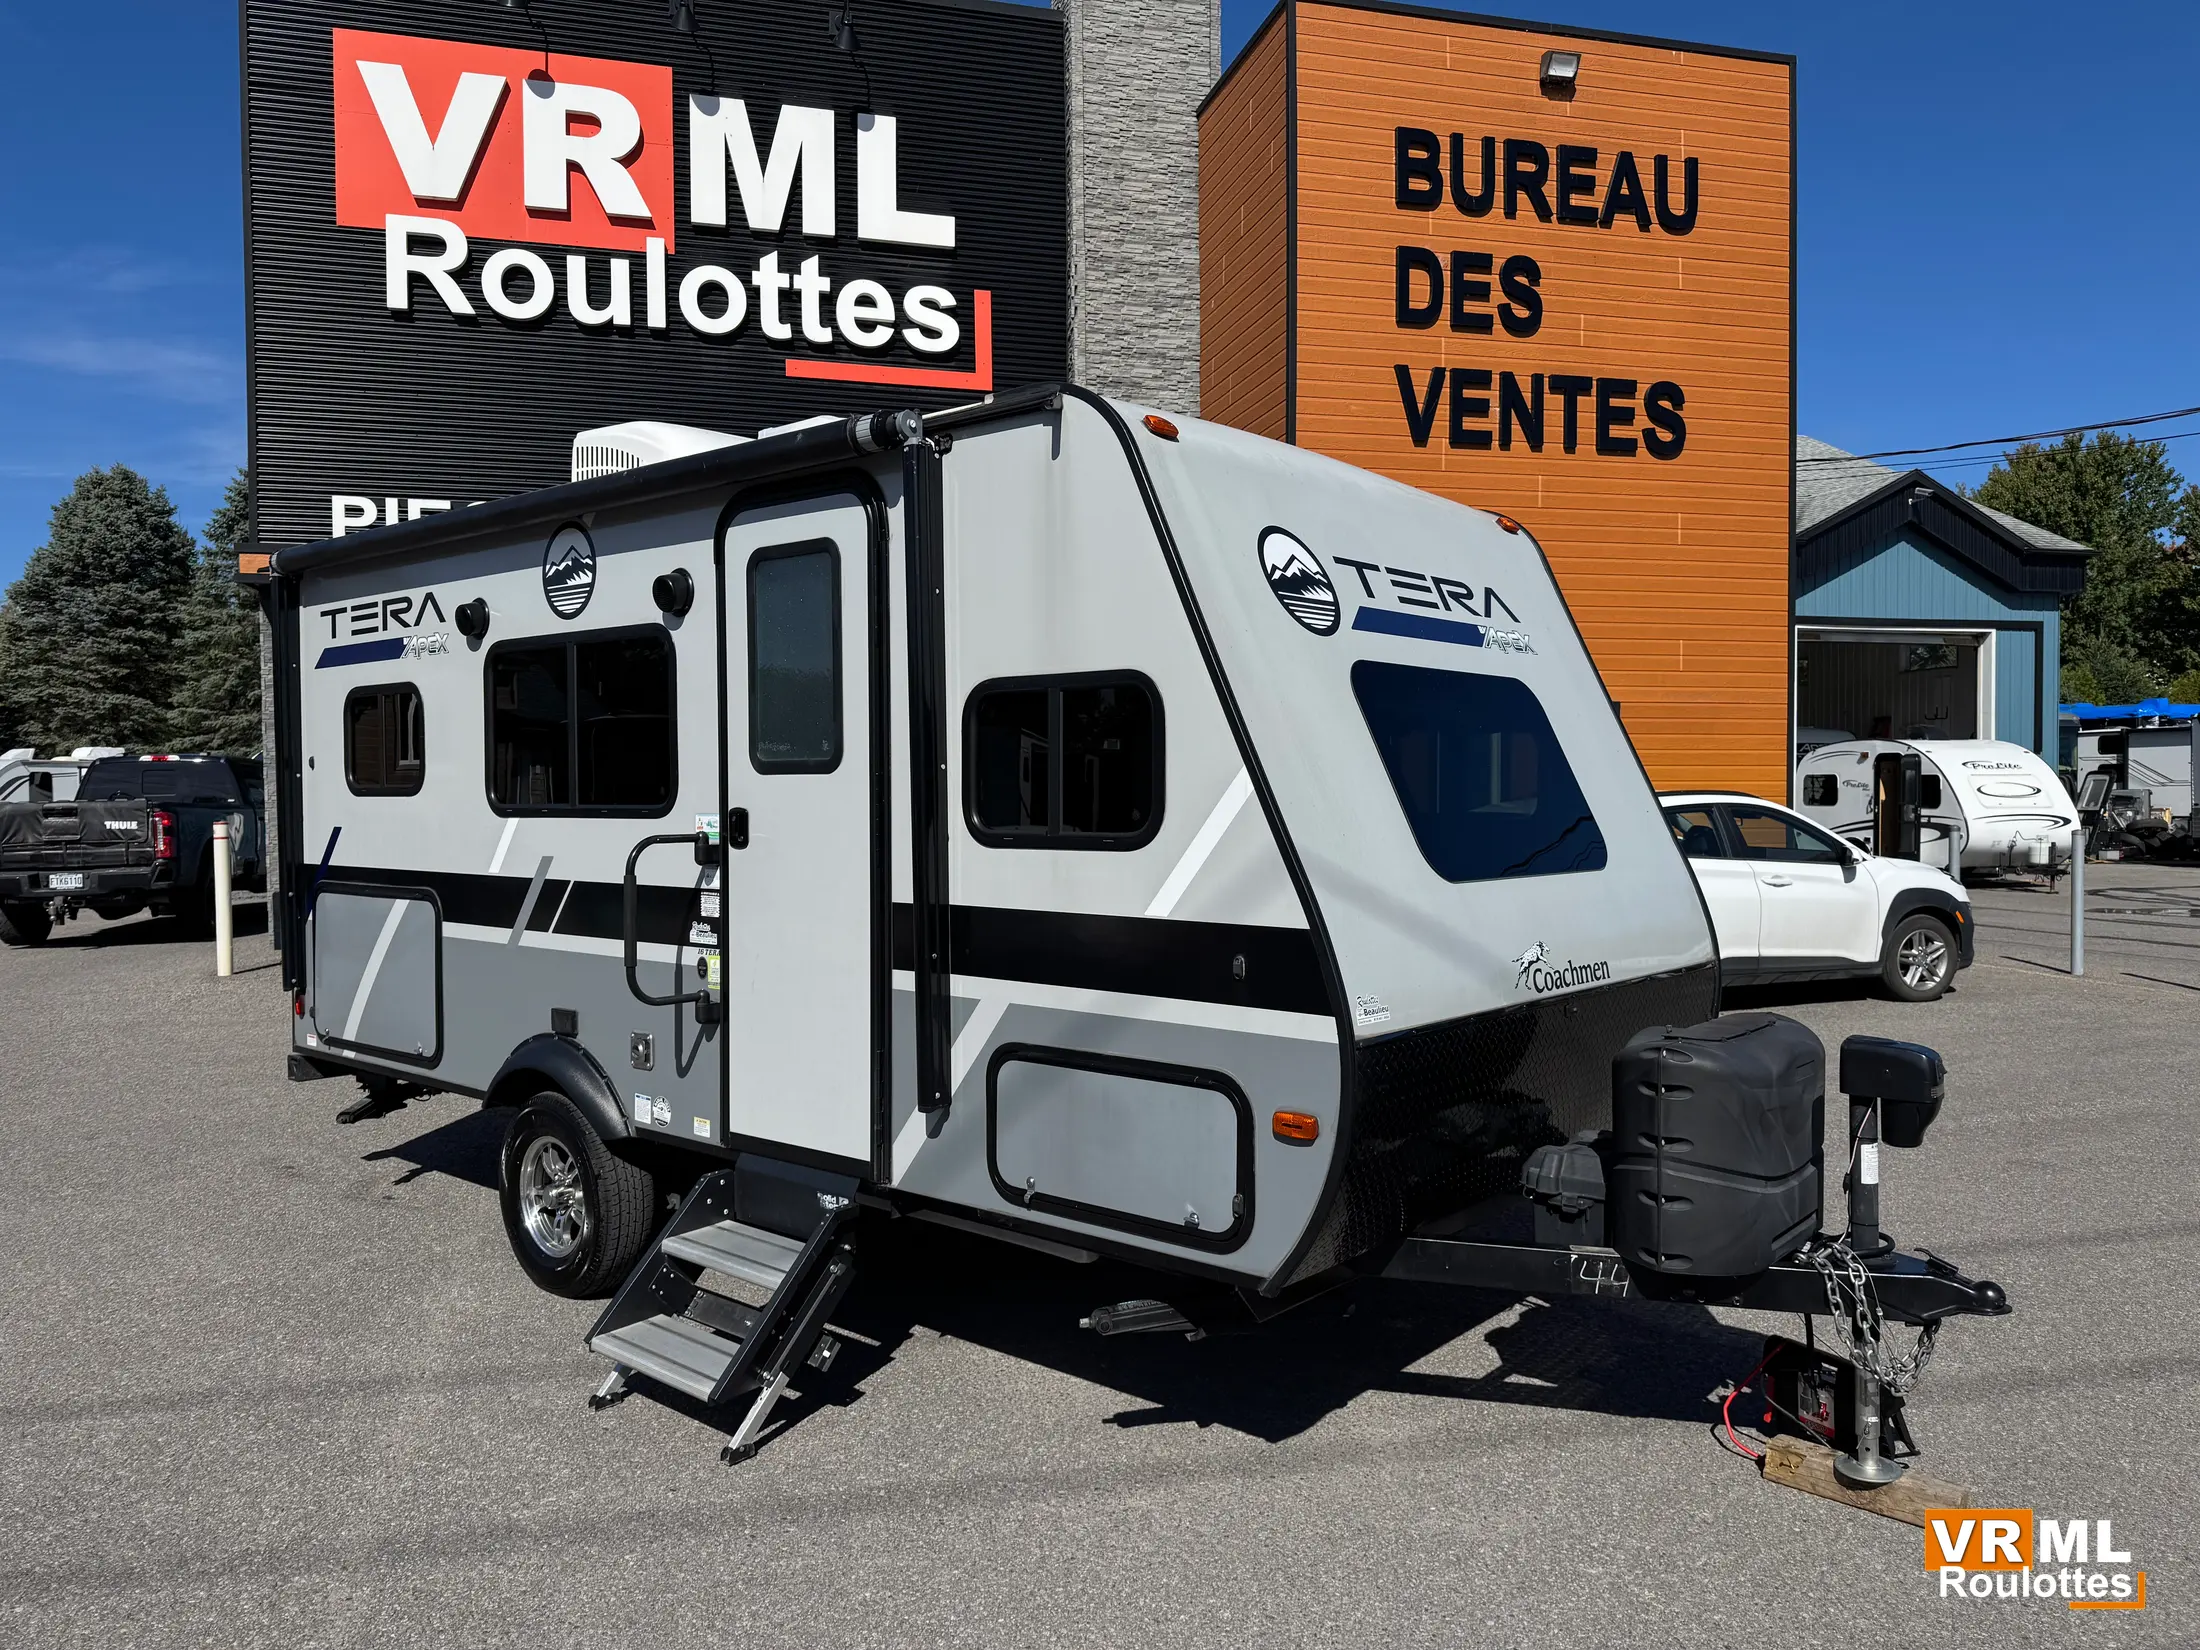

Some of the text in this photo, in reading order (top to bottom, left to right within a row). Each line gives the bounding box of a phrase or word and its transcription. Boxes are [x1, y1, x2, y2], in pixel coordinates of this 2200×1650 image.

[1394, 126, 1699, 236] BUREAU
[385, 214, 961, 354] Roulottes
[1395, 245, 1543, 338] DES
[1394, 364, 1687, 461] VENTES
[320, 592, 446, 639] TERA
[1332, 556, 1521, 623] TERA
[104, 821, 138, 829] THULE
[50, 877, 82, 886] FTK6110
[1533, 960, 1610, 993] Coachmen
